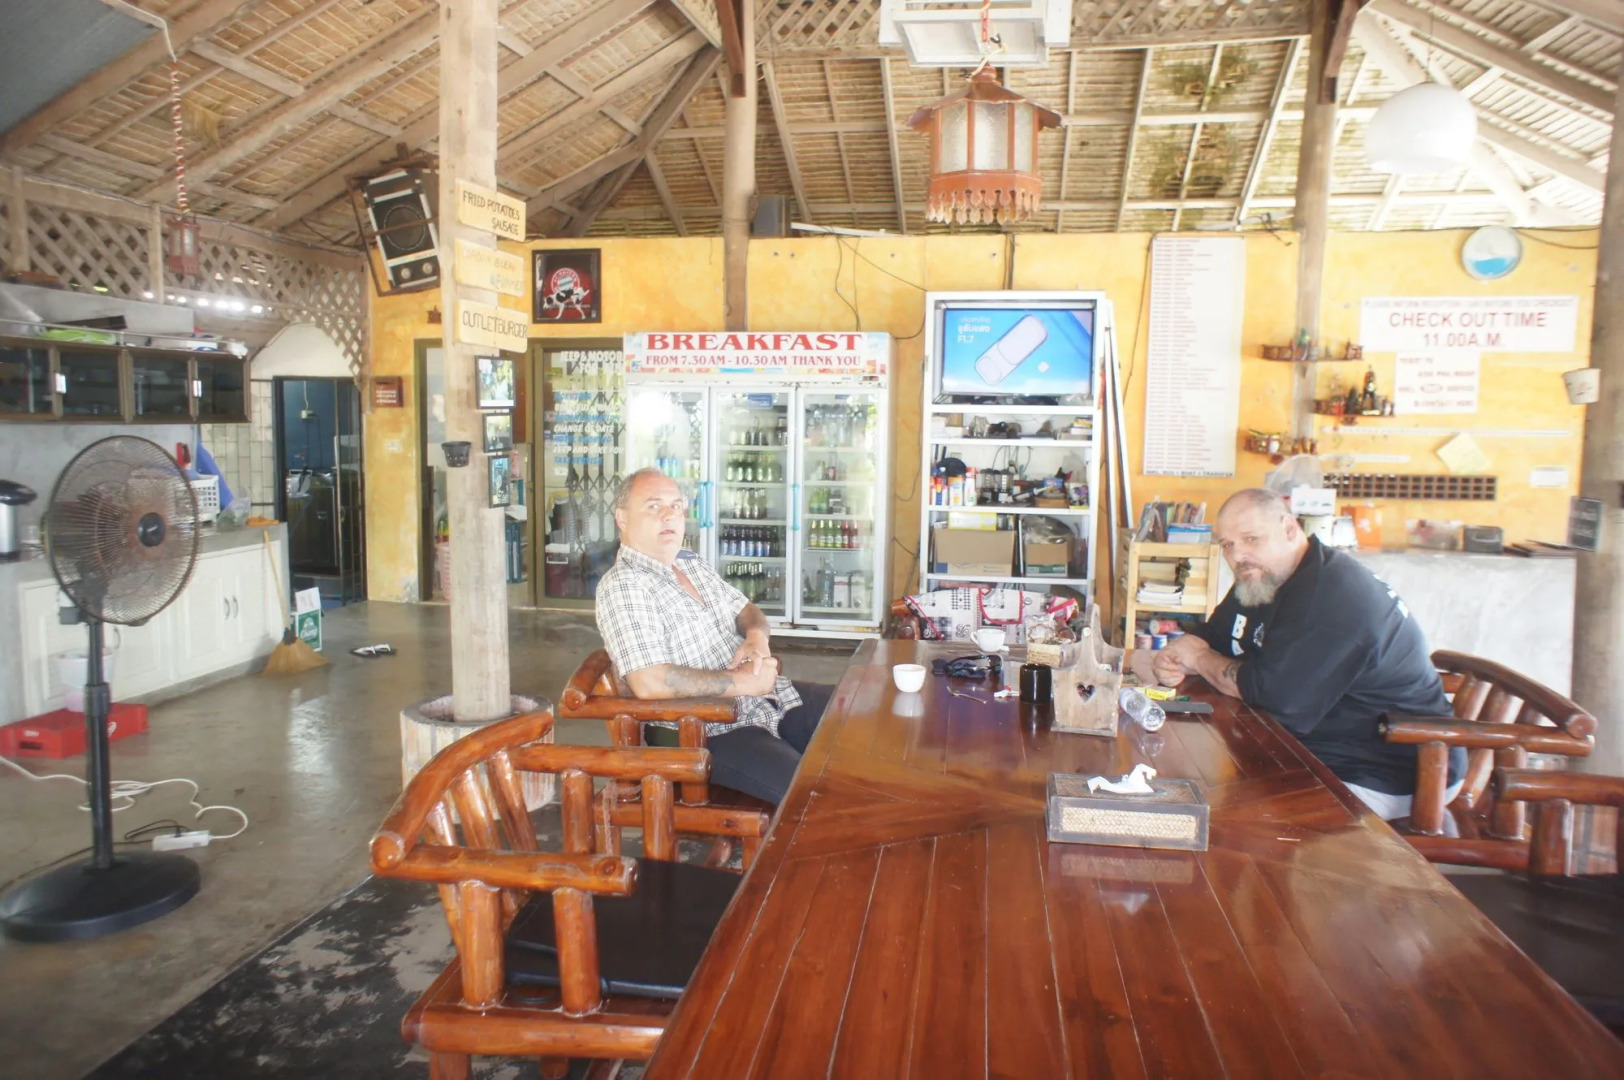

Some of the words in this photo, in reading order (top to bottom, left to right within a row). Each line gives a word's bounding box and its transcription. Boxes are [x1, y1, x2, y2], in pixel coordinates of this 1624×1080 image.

[463, 190, 486, 208] FRIED
[487, 199, 520, 220] POTATOES
[491, 217, 519, 236] SAUSAGE
[1389, 312, 1453, 328] CHECK
[1459, 312, 1498, 327] OUT
[1503, 312, 1547, 327] TIME
[646, 334, 862, 351] BREAKFAST
[645, 355, 679, 365] FROM
[791, 355, 833, 366] THANK
[835, 355, 861, 366] YOU
[553, 424, 583, 433] CHANGE
[596, 424, 615, 433] DATE
[552, 445, 573, 453] JEEP
[573, 445, 589, 454] AND
